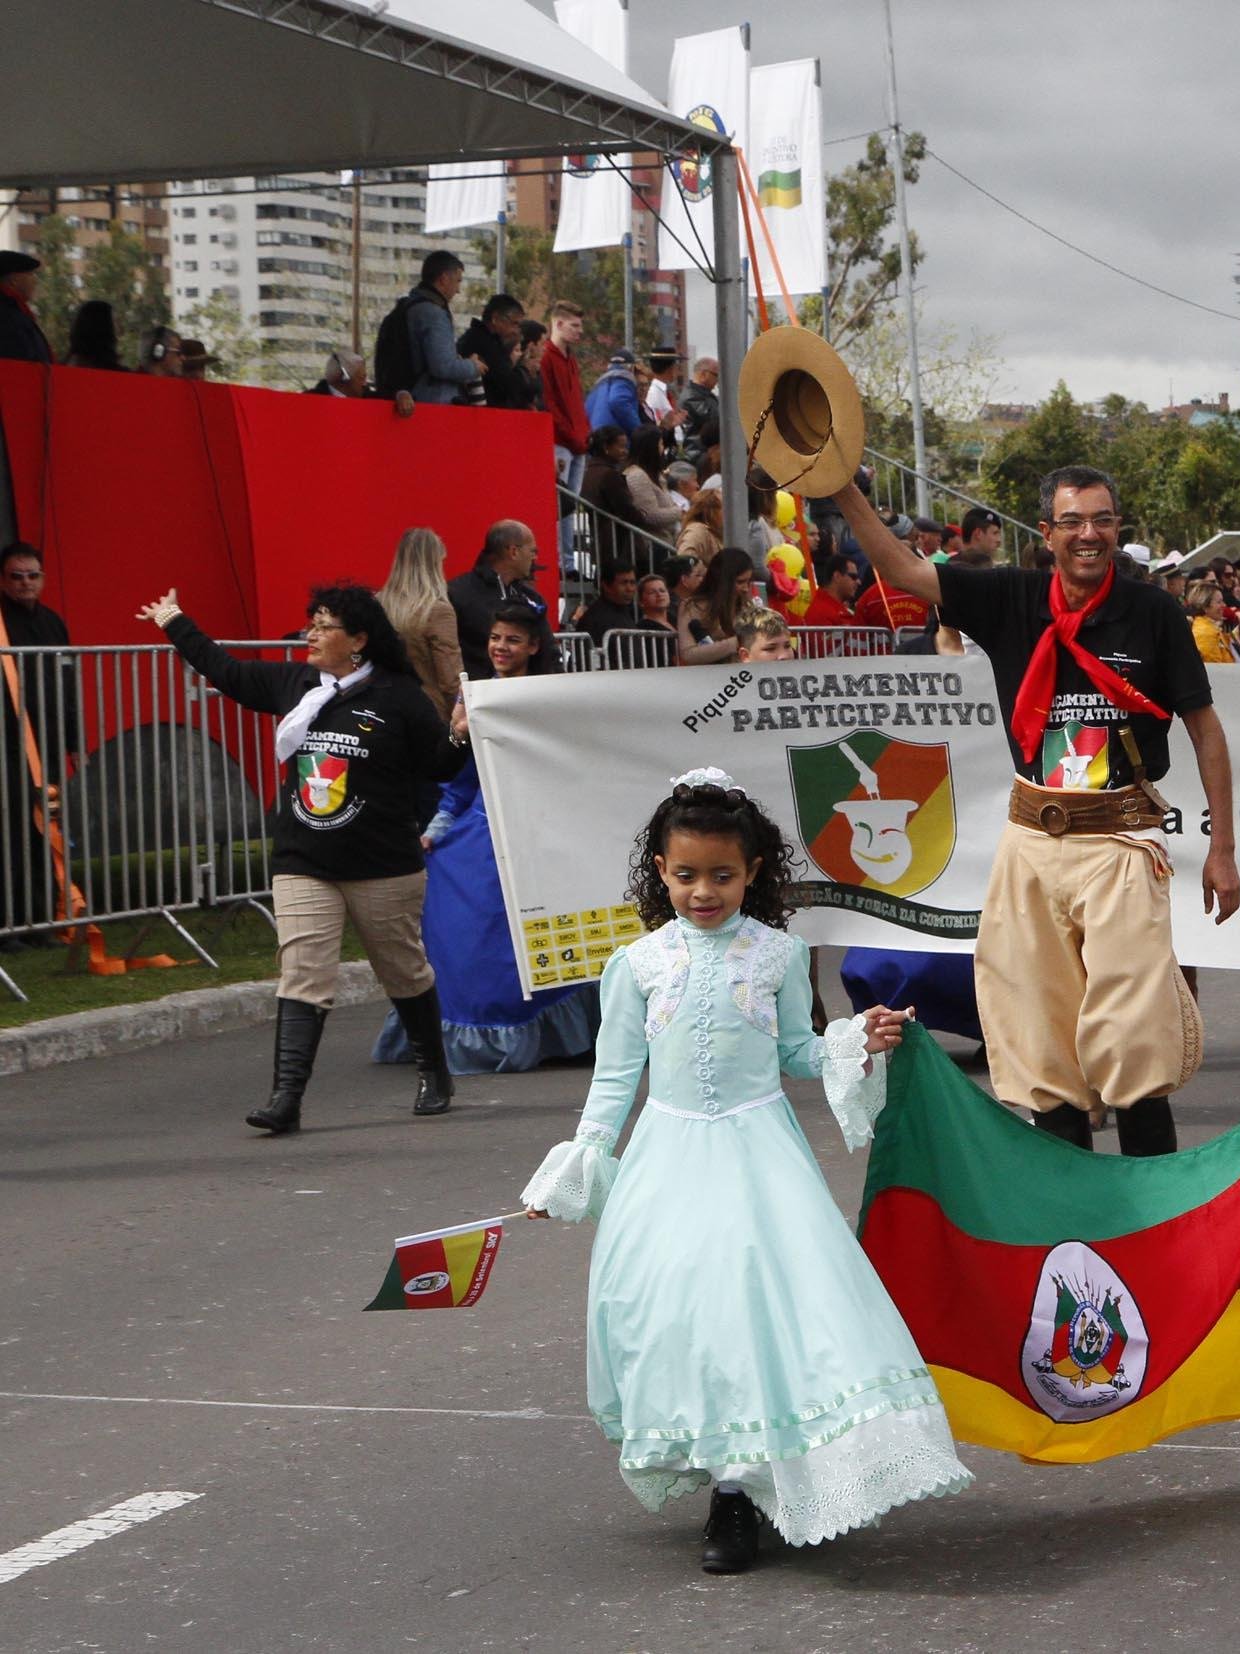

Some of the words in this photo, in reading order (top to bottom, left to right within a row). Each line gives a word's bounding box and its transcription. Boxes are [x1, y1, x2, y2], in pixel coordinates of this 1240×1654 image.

[682, 668, 753, 733] Piquete
[757, 672, 963, 702] ORÇAMENTO
[731, 702, 997, 732] PARTICIPATIVO
[900, 908, 916, 924] DA
[919, 911, 981, 929] COMUNID
